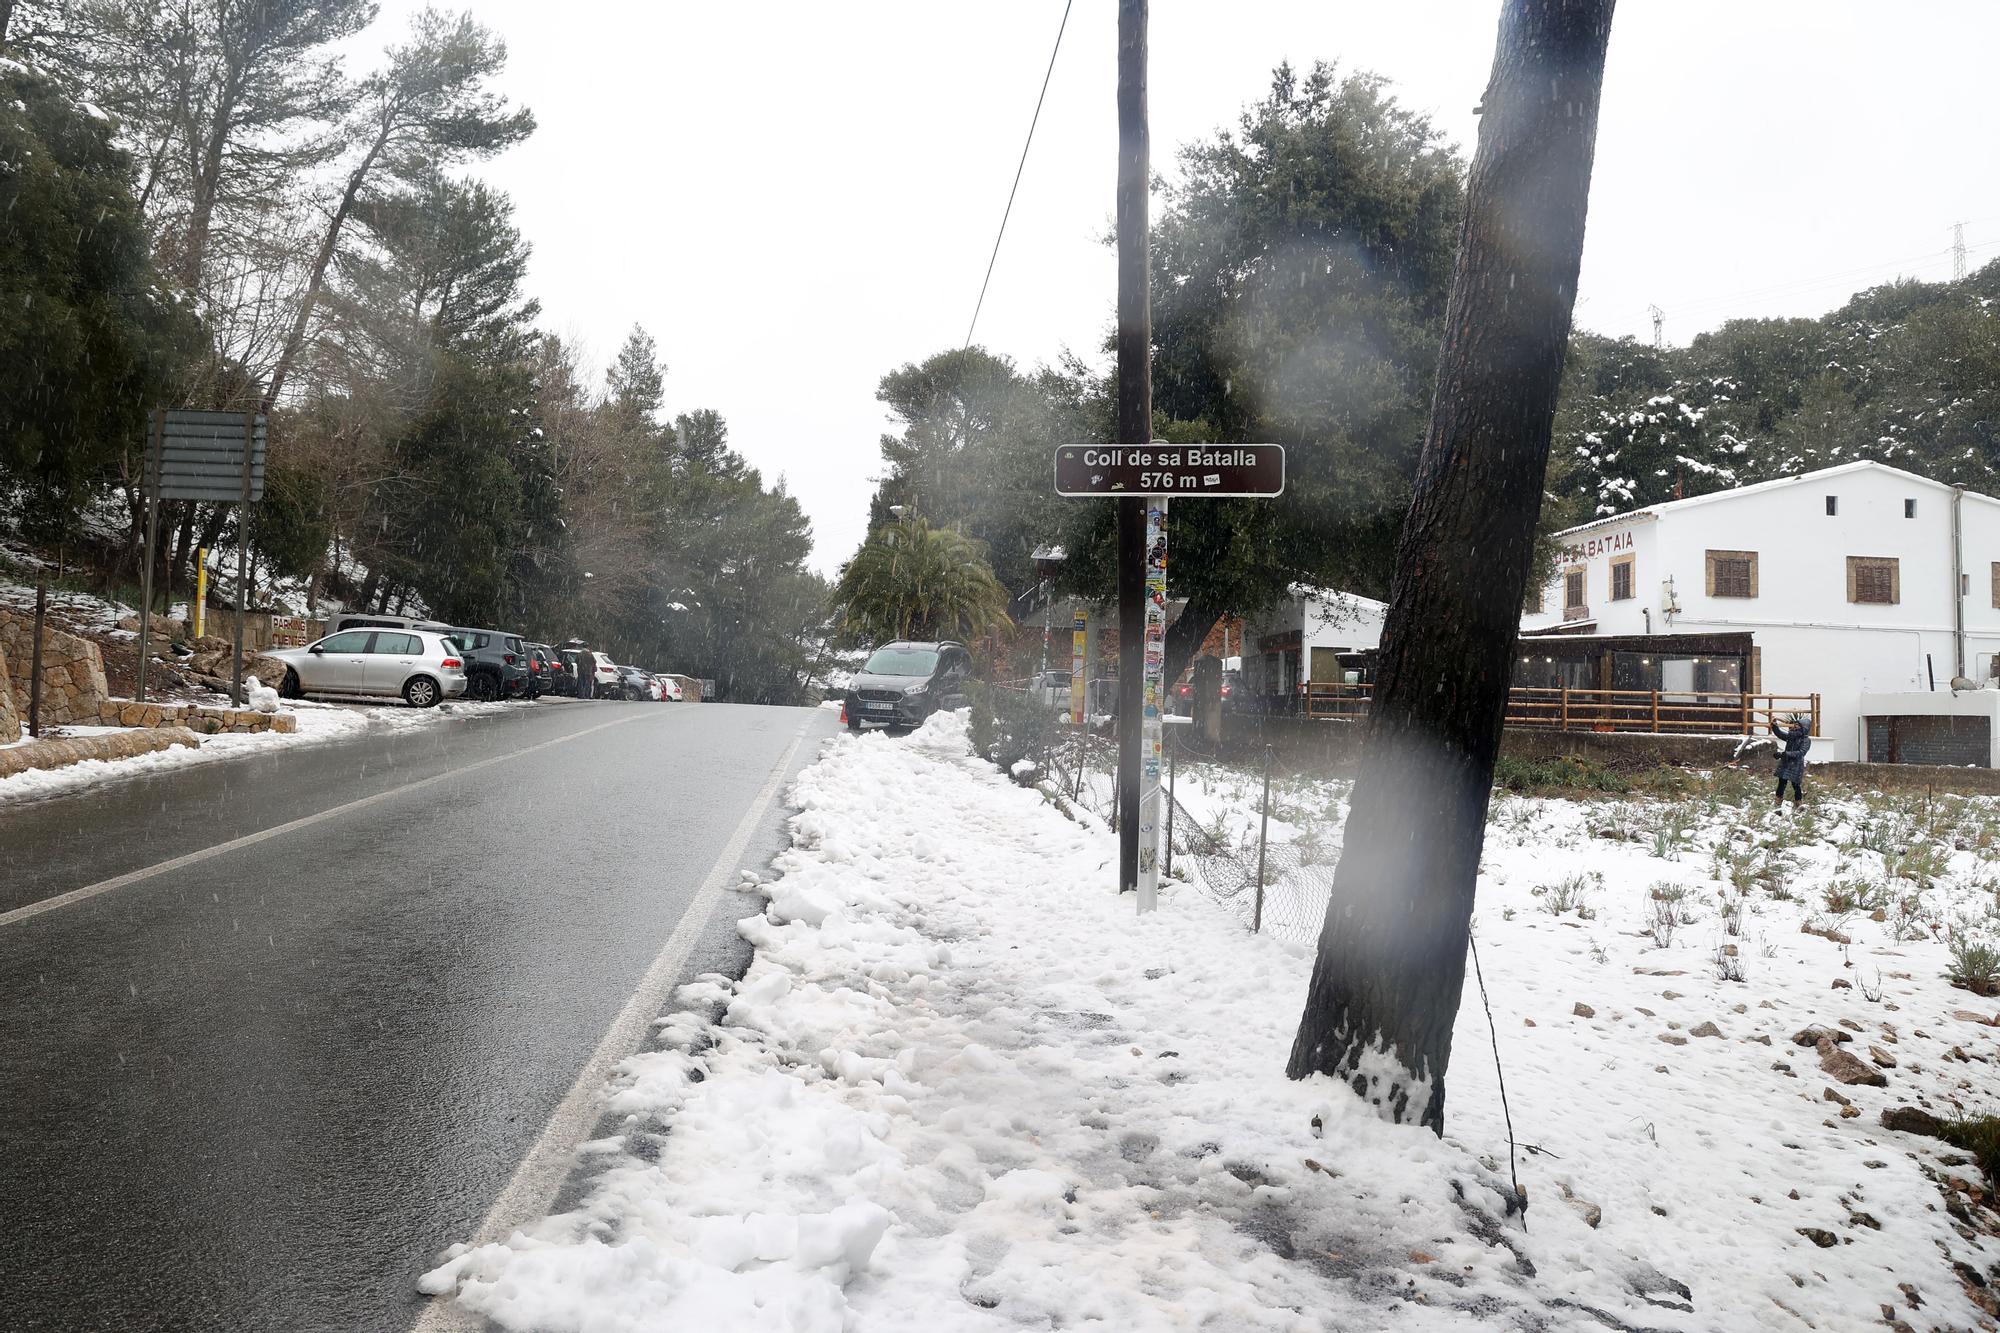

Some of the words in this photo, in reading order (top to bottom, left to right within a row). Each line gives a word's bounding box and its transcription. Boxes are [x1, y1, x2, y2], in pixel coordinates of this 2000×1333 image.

[1083, 449, 1122, 466] Coll
[1128, 449, 1152, 466] de
[1157, 453, 1181, 466] sa
[1187, 449, 1257, 466] Batalla
[1140, 472, 1174, 488] 576
[1179, 475, 1197, 488] m
[273, 618, 306, 631] PARKING
[272, 633, 307, 646] CLIENTES
